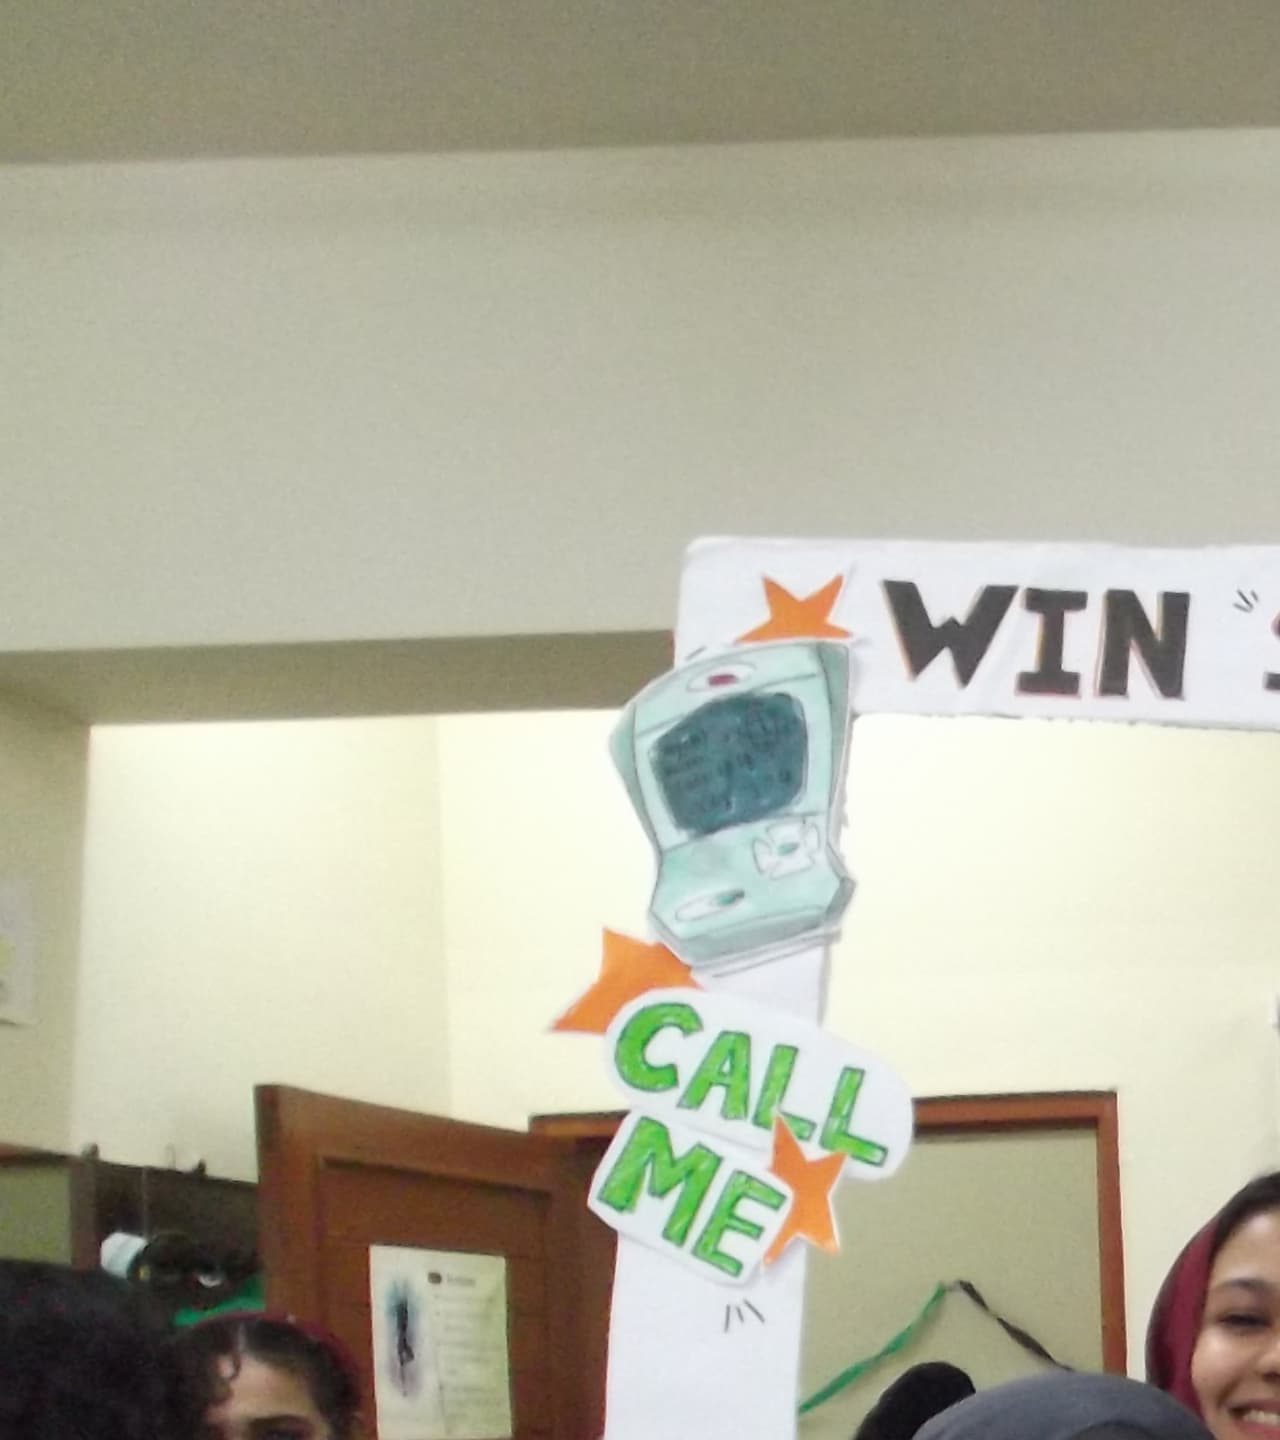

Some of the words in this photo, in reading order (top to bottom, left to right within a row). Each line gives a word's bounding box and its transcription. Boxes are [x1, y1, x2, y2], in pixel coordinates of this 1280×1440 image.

[883, 579, 1190, 700] WIN
[614, 1002, 889, 1168] CALL
[597, 1115, 788, 1278] ME
